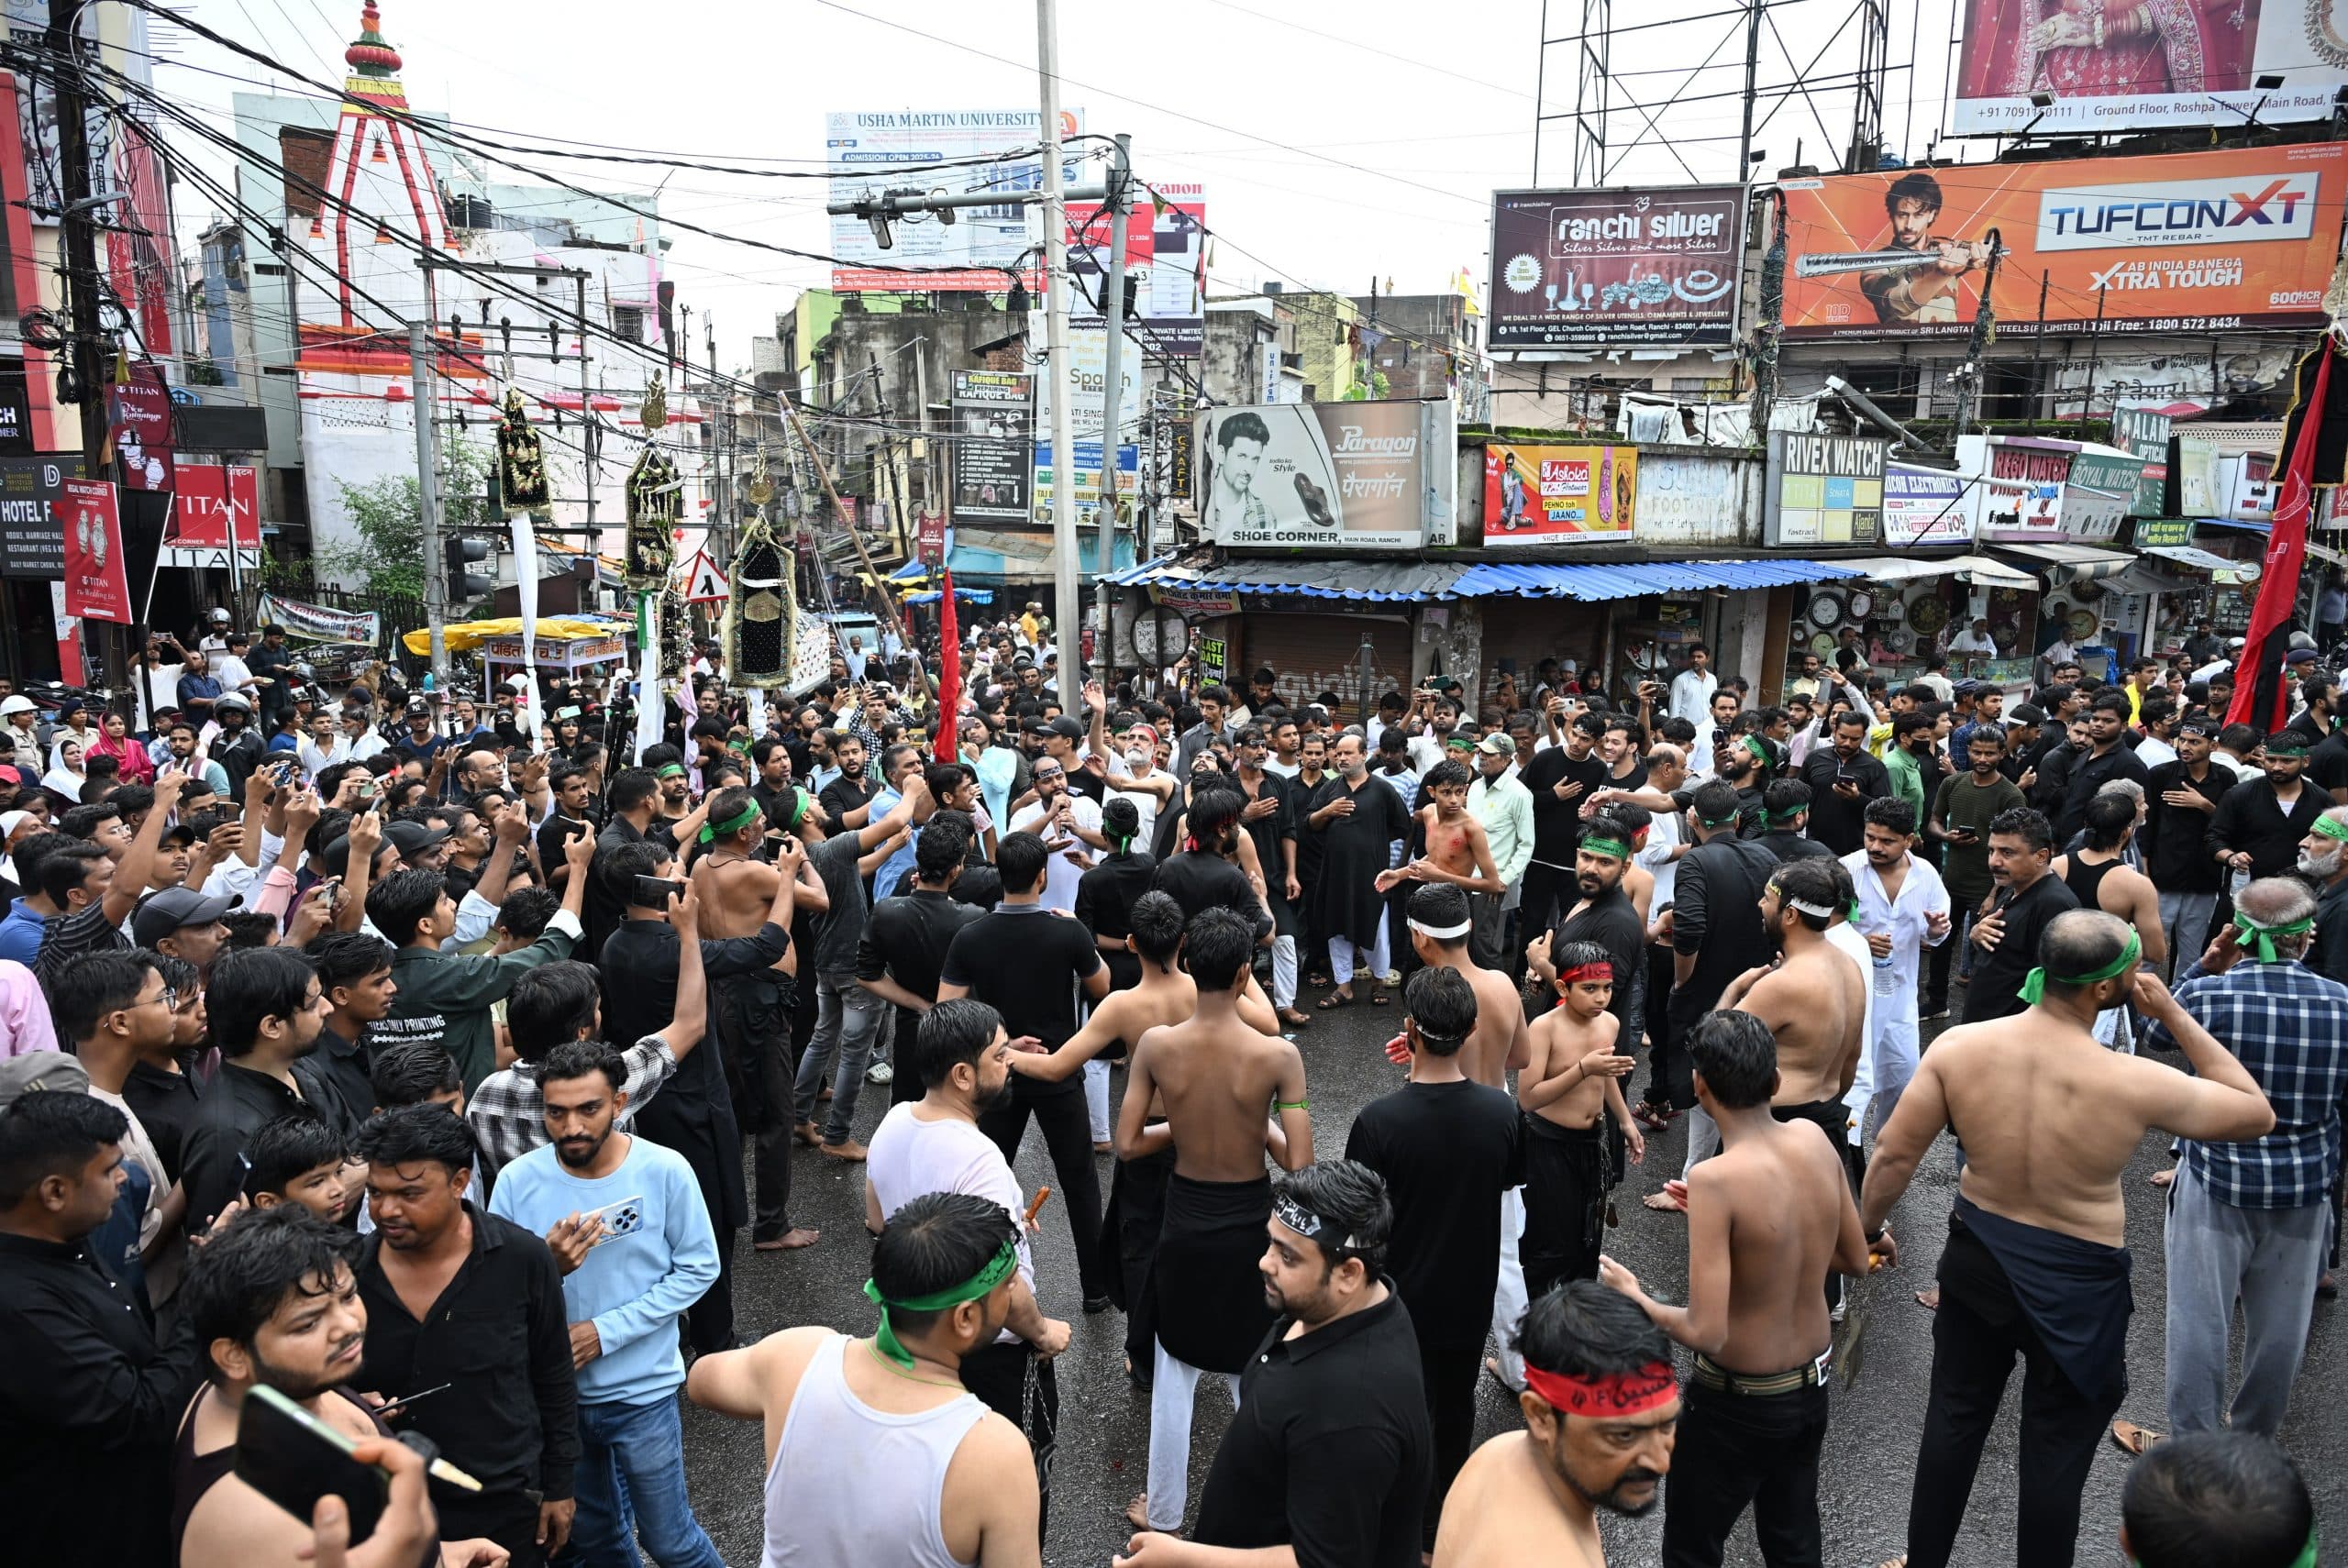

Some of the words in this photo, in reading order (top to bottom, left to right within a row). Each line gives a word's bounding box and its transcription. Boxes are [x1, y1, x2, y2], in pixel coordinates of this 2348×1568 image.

[1977, 105, 2000, 117] +91
[2094, 103, 2136, 116] Ground
[2138, 102, 2169, 116] Floor,
[2174, 101, 2215, 117] Roshpa
[2260, 96, 2290, 109] Main
[2294, 94, 2327, 108] Road,
[858, 115, 894, 127] USHA
[898, 113, 956, 127] MARTIN
[960, 112, 1043, 126] UNIVERSITY
[845, 154, 887, 162] ADMISSION
[889, 153, 910, 161] OPEN
[1146, 183, 1202, 194] Canon
[1558, 213, 1640, 241] ranchi
[1651, 211, 1724, 238] silver
[1563, 242, 1593, 254] Silver
[1596, 241, 1626, 253] Silver
[1656, 242, 1682, 250] more
[1686, 238, 1717, 249] Silver
[2127, 262, 2147, 273] AB
[2149, 260, 2184, 271] INDIA
[2187, 258, 2243, 271] BANEGA
[2088, 261, 2160, 292] XTRA
[2169, 268, 2243, 288] TOUGH
[2269, 292, 2298, 304] 600
[2298, 291, 2321, 300] HCR
[1699, 322, 1732, 330] Jharkhand
[1935, 326, 1969, 334] LANGTA
[1996, 325, 2029, 333] STEELS
[2044, 323, 2080, 333] LIMITED
[2113, 320, 2144, 331] Free:
[2148, 319, 2178, 330] 1800
[2182, 318, 2206, 329] 572
[2209, 316, 2241, 327] 8434
[1070, 368, 1131, 392] Spah
[128, 386, 160, 395] TITAN
[1083, 410, 1104, 418] SING
[2133, 413, 2169, 444] ALAM
[1335, 425, 1417, 451] Paragon
[1787, 436, 1831, 474] RIVEX
[1834, 438, 1882, 476] WATCH
[2139, 444, 2167, 464] OPTICAL
[1273, 464, 1296, 472] Style
[1545, 464, 1589, 481] Ashoka
[1993, 452, 2027, 480] REGO
[2027, 454, 2070, 482] WATCH
[1342, 470, 1406, 499] पैरागॉन
[1909, 476, 1959, 493] ELECTRONICS
[2073, 463, 2103, 486] ROYAL
[2104, 467, 2141, 490] WATCH
[67, 484, 80, 493] REGAL
[80, 485, 92, 495] WATCH
[92, 487, 108, 497] CORNER
[1561, 482, 1588, 492] Footwear
[1828, 489, 1851, 498] SONATA
[1, 501, 41, 522] HOTEL
[1854, 512, 1876, 530] Ajanta
[1232, 530, 1272, 541] SHOE
[1276, 531, 1342, 545] CORNER,
[171, 550, 257, 567] ITAN
[90, 577, 108, 587] TITAN
[1202, 638, 1223, 654] LAST
[1201, 650, 1224, 666] DATE
[404, 1014, 446, 1032] PRINTING
